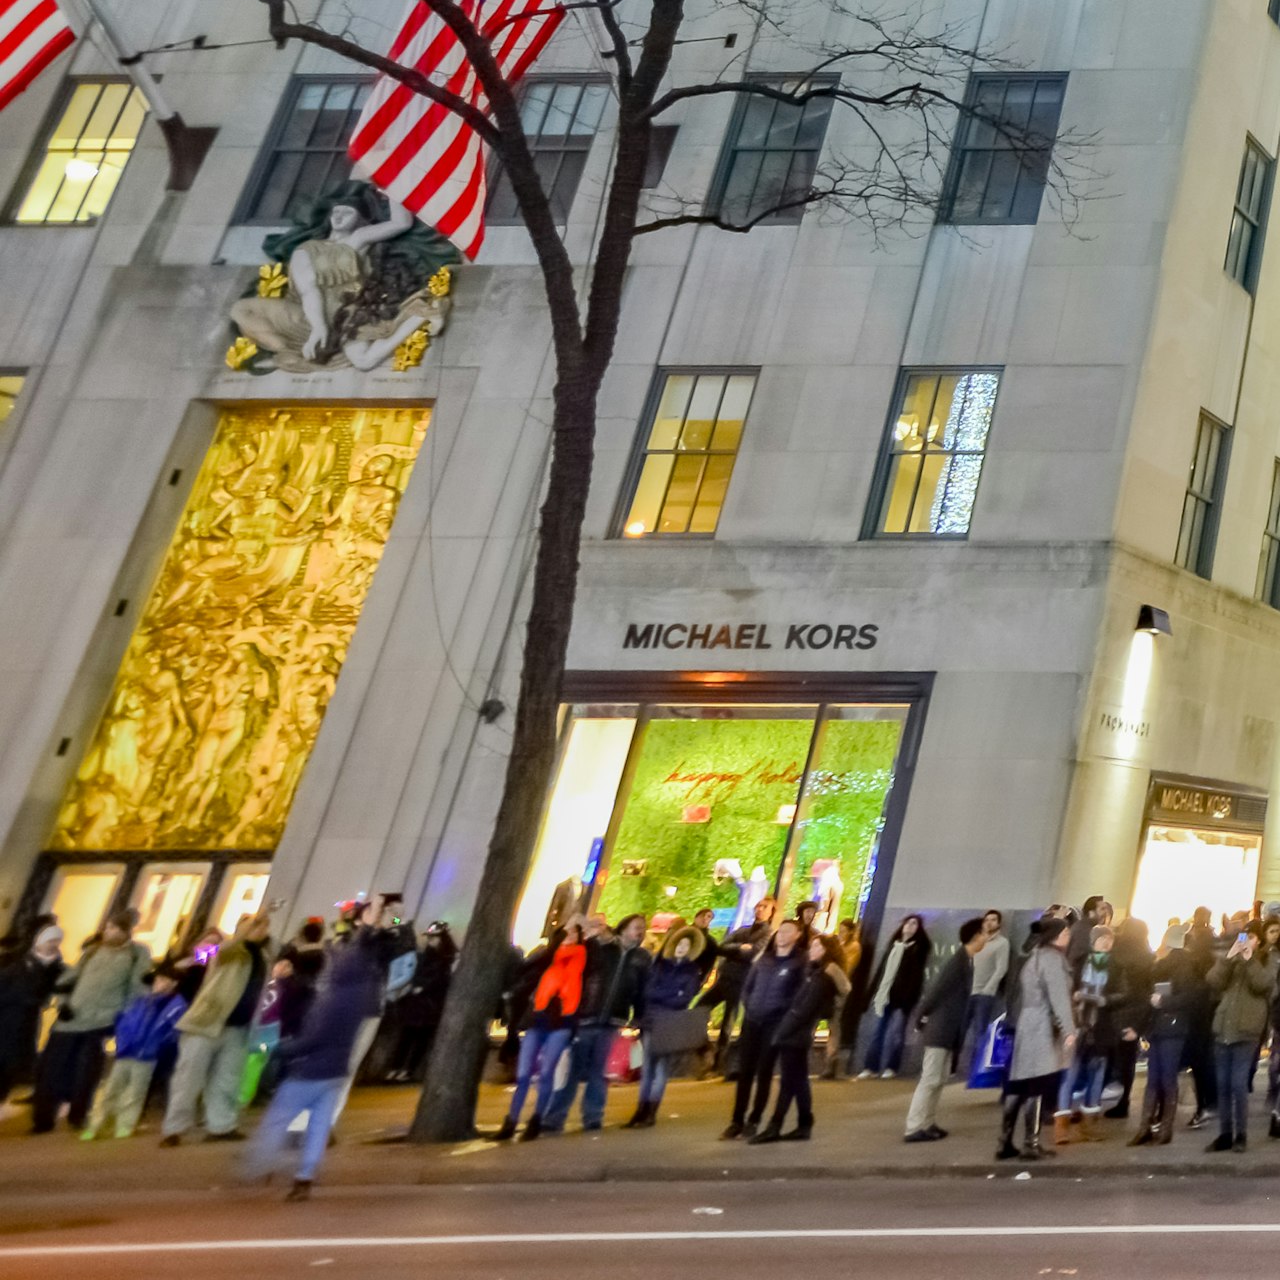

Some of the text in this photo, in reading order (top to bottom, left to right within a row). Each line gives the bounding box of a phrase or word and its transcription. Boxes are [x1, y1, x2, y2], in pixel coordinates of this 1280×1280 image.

[622, 623, 880, 650] MICHAEL KORS
[1160, 788, 1204, 813] MICHAEL
